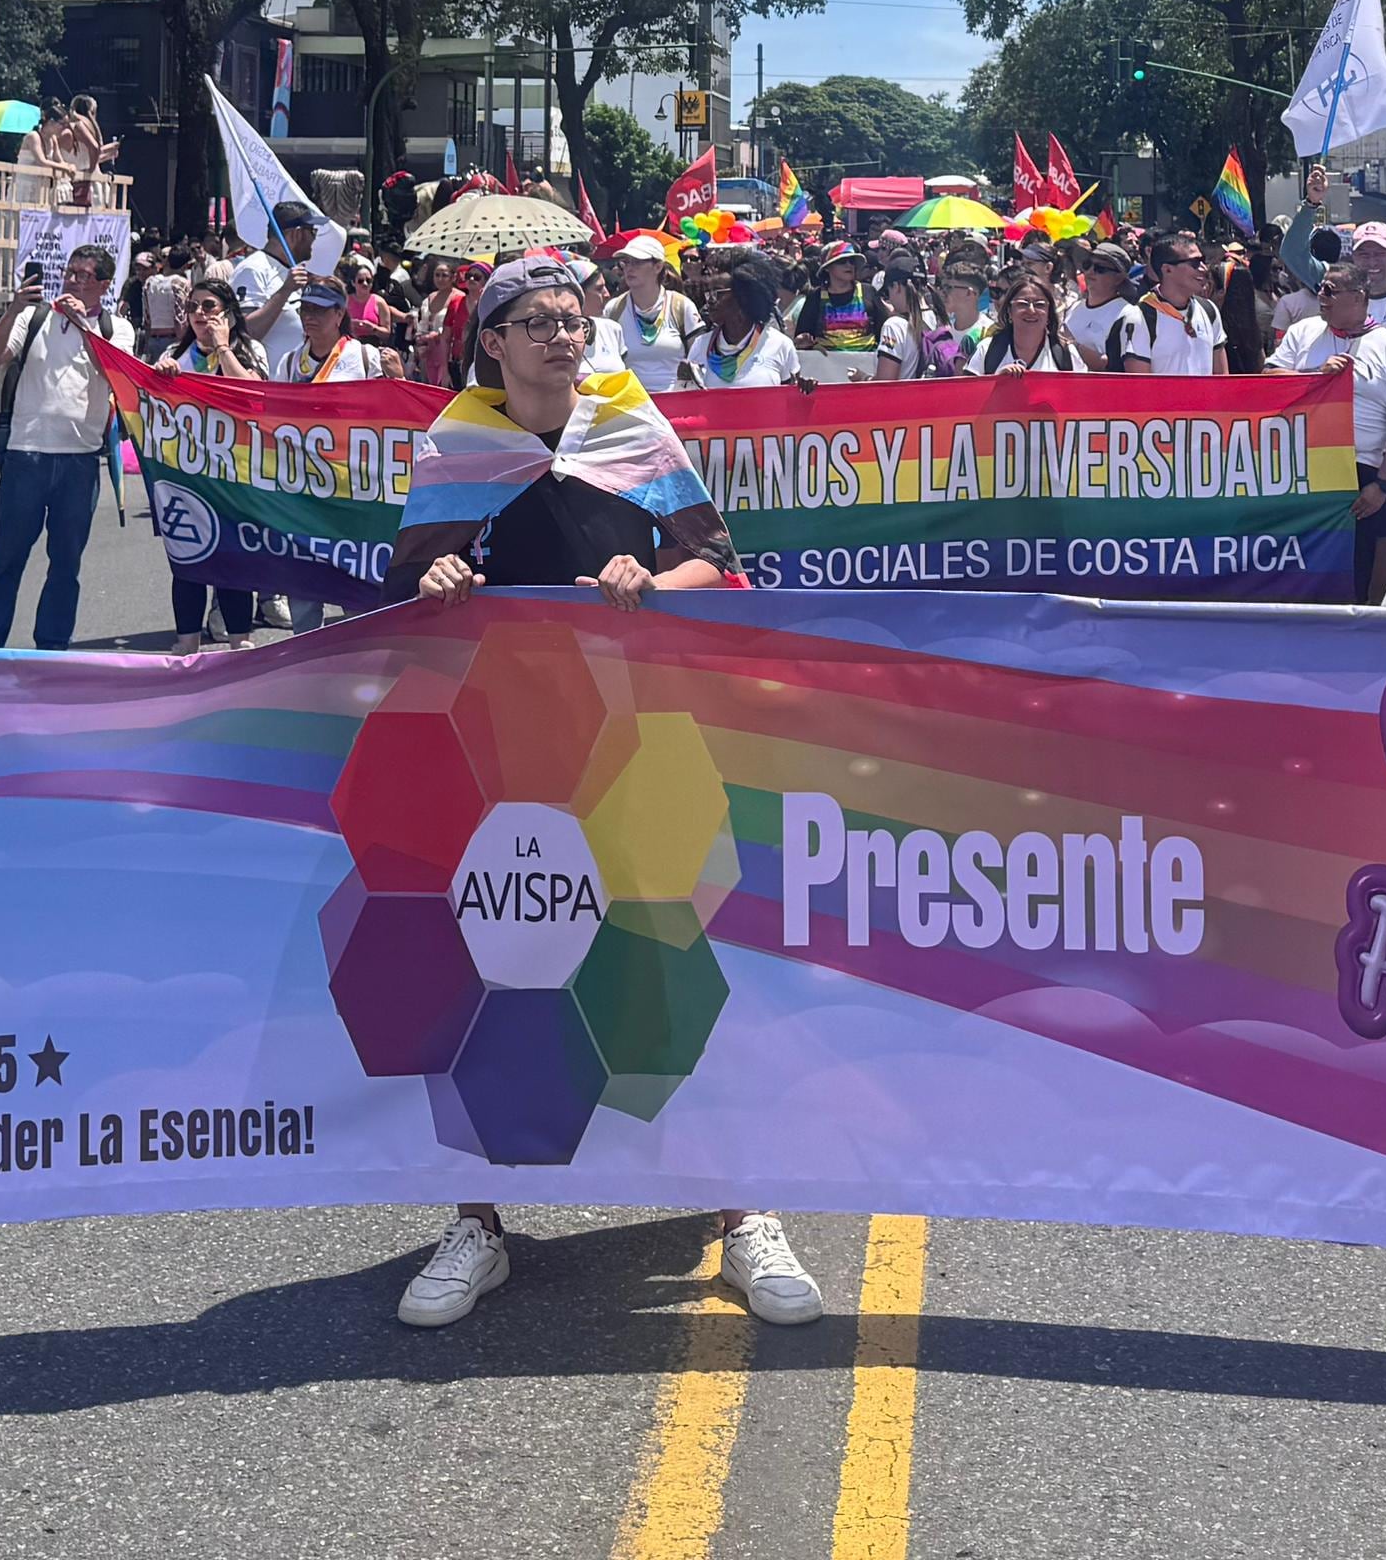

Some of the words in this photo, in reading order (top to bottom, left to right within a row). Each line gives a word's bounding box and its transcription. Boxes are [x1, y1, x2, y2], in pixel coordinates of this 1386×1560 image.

[1014, 164, 1035, 194] BAC
[1049, 164, 1072, 196] BAC
[248, 419, 336, 499] LOS
[872, 427, 908, 505] Y
[918, 423, 981, 503] LA
[992, 413, 1311, 500] DIVERSIDAD!
[799, 538, 991, 588] SOCIALES
[1005, 538, 1058, 578] DE
[1067, 537, 1200, 577] COSTA
[1213, 534, 1306, 576] RICA
[514, 834, 542, 860] LA
[781, 791, 1206, 956] Presente
[456, 871, 603, 924] AVISPA
[79, 1112, 124, 1167] La
[138, 1099, 316, 1163] Esencia!
